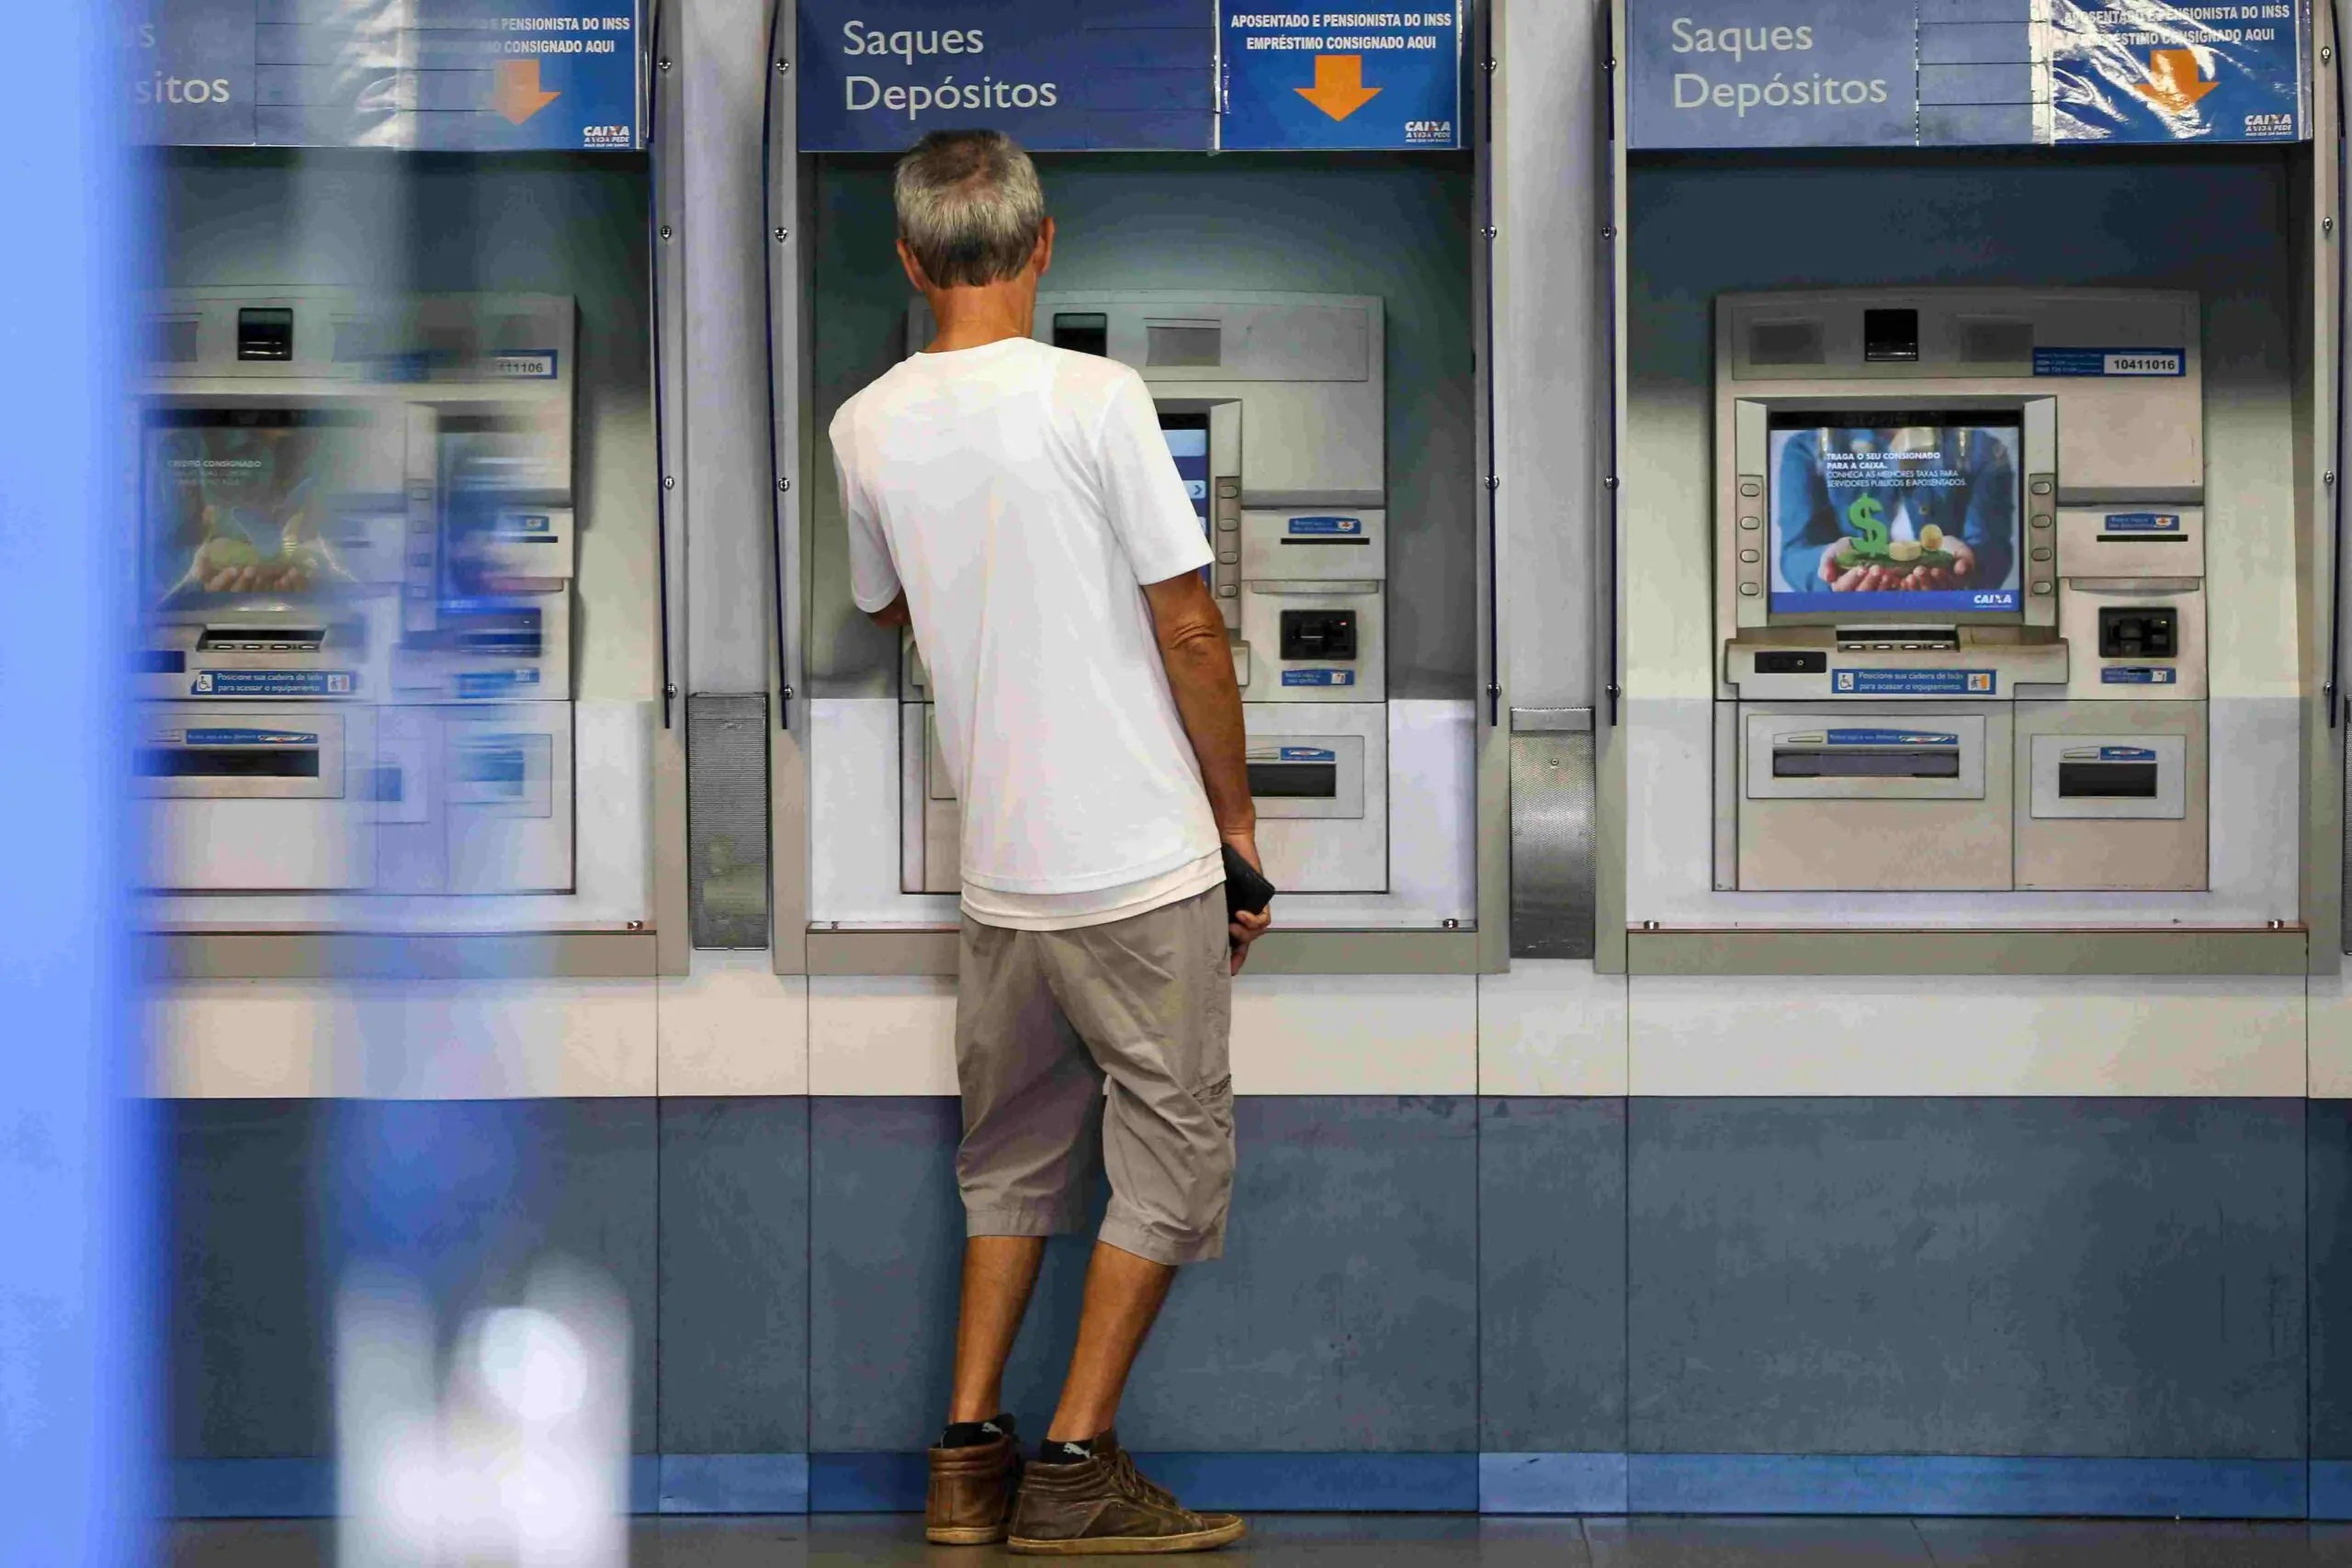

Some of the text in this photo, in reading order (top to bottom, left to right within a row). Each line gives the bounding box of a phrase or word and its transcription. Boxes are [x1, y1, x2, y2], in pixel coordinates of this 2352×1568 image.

[2241, 6, 2259, 19] DO
[2261, 4, 2290, 18] INSS
[501, 17, 578, 30] PENSIONISTA
[582, 17, 599, 30] DO
[602, 17, 630, 30] INSS
[1231, 13, 1452, 28] APOSENTADO E PENSIONISTA DO INSS
[1671, 17, 1813, 62] Saques
[2245, 27, 2275, 41] AQUI
[504, 39, 582, 53] CONSIGNADO
[585, 39, 615, 53] AQUI
[843, 20, 984, 65] Saques
[1247, 34, 1437, 50] EMPRÉSTIMO CONSIGNADO AQUI
[846, 75, 1057, 120] Depósitos
[1675, 73, 1887, 118] Depósitos
[1405, 120, 1451, 131] CAIXA
[2245, 114, 2292, 126] CAIXA
[582, 125, 629, 136] CAIXA
[2114, 359, 2176, 370] 10411016
[1826, 451, 1941, 460] TRAGA O SEU CONSIGNADO
[1917, 469, 1939, 478] TAXAS
[1939, 469, 1959, 478] PARA
[1973, 594, 2012, 604] CAIXA
[217, 672, 252, 681] Posicione
